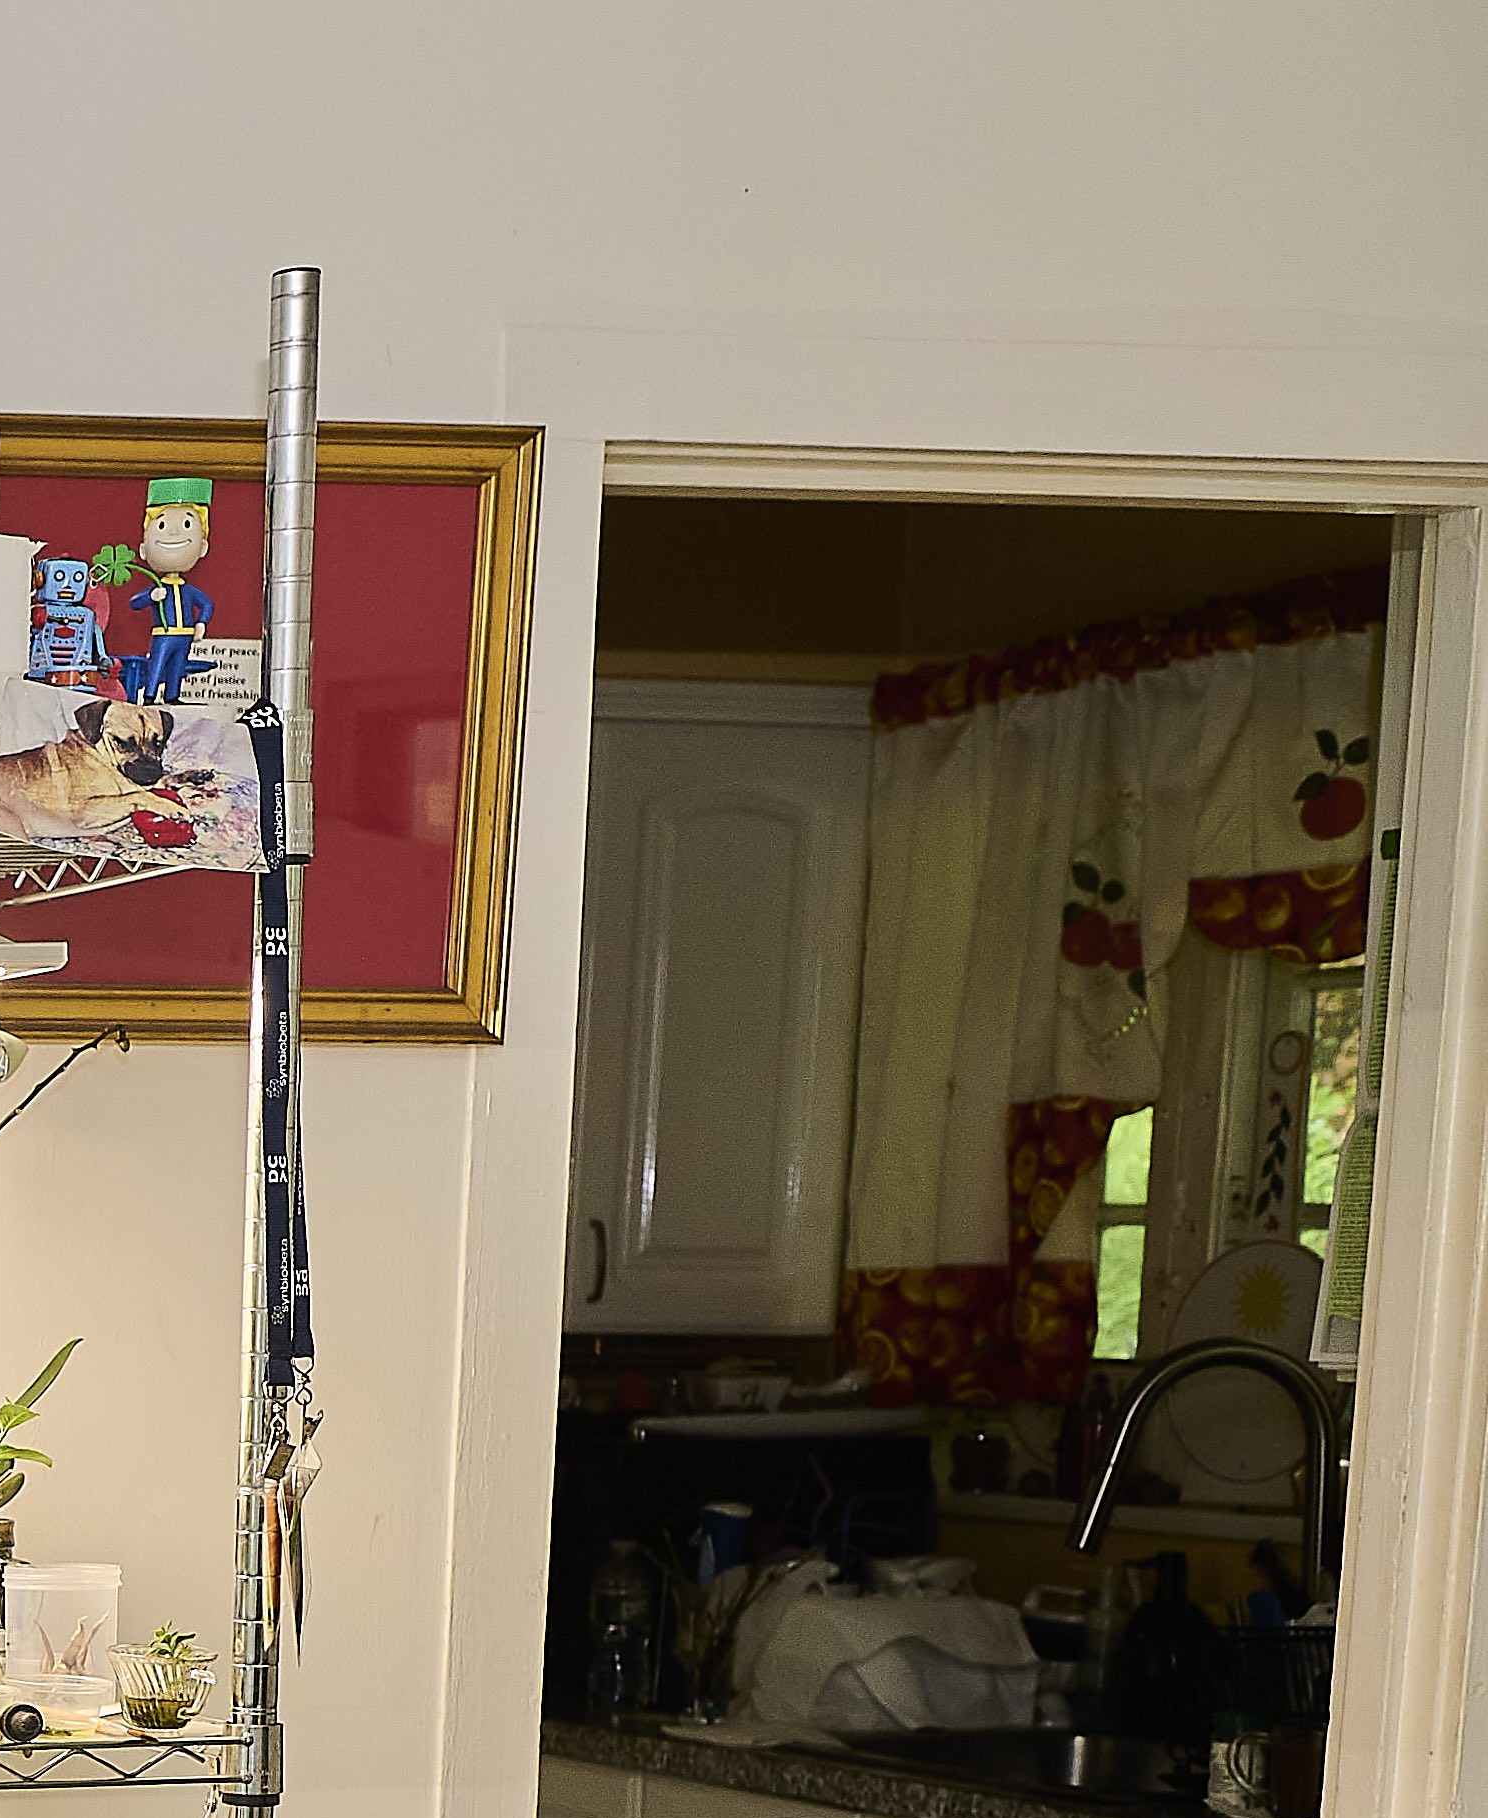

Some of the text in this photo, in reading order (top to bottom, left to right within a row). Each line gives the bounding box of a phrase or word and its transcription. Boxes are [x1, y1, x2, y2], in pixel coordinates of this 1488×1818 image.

[211, 645, 226, 655] for
[195, 689, 206, 698] of
[201, 674, 210, 684] of
[213, 675, 247, 686] justice
[276, 782, 285, 859] synbiobeta
[279, 1011, 287, 1087] synbiobeta
[280, 1238, 289, 1313] synbiobeta
